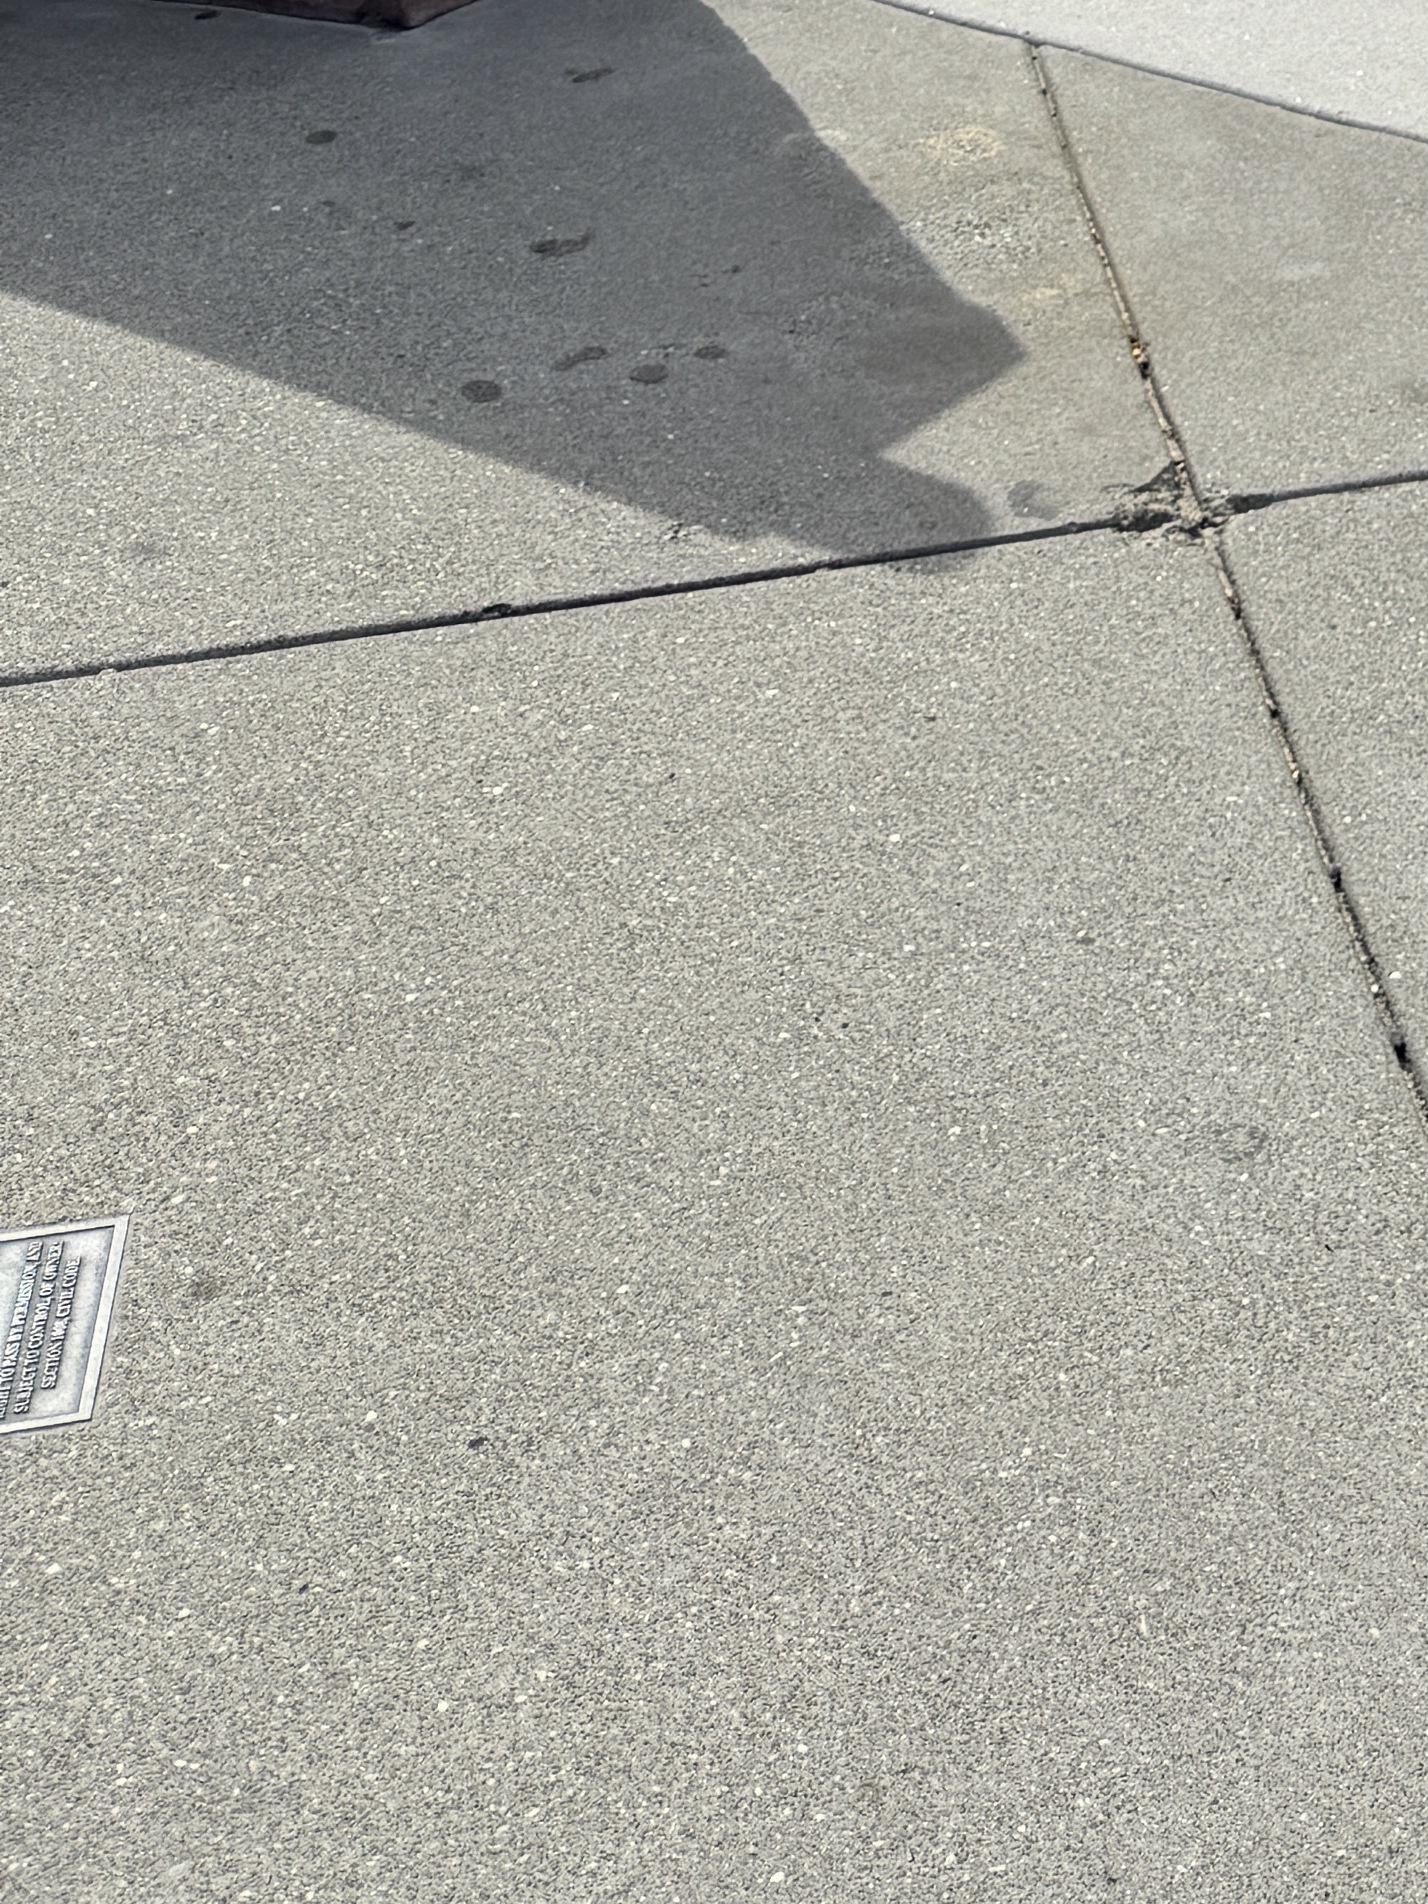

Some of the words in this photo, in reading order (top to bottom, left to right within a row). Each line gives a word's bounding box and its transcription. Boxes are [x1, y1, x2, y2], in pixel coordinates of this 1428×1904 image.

[23, 1349, 40, 1366] TO
[41, 1342, 62, 1389] SECTION
[13, 1367, 36, 1413] SUBJECT
